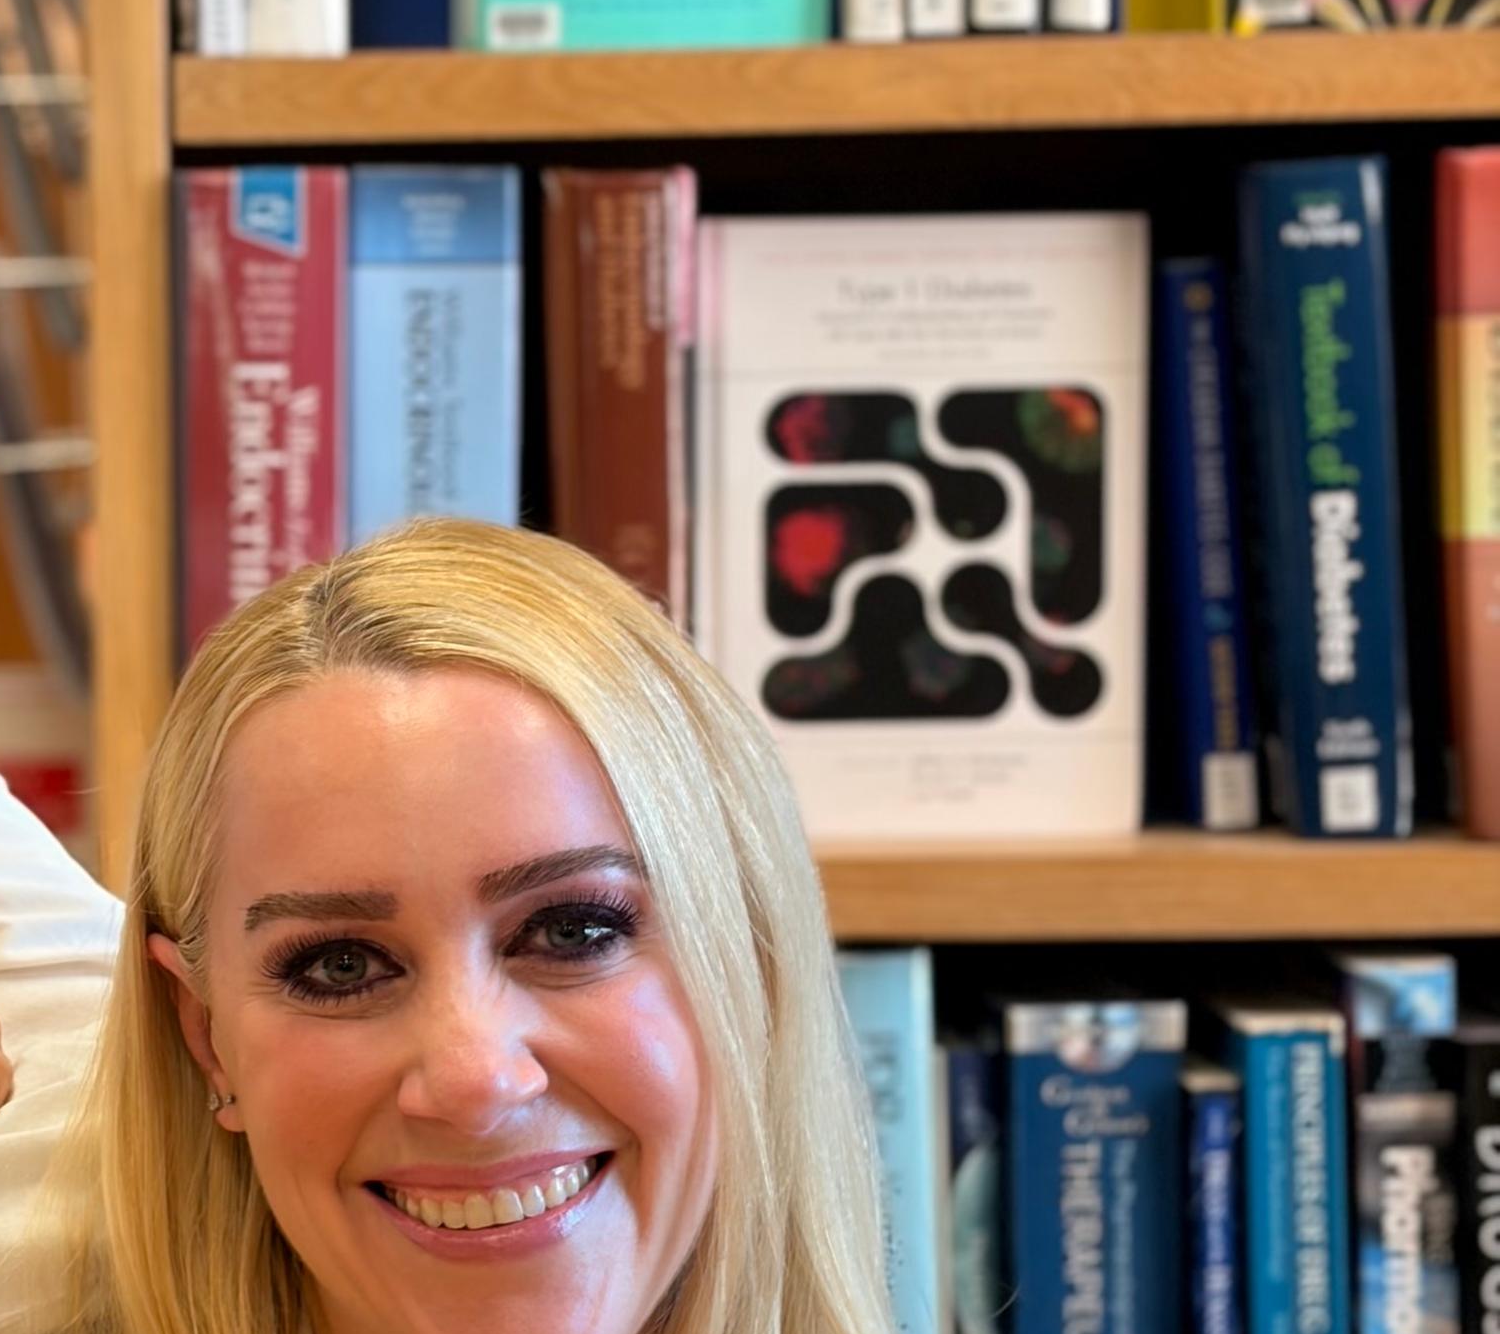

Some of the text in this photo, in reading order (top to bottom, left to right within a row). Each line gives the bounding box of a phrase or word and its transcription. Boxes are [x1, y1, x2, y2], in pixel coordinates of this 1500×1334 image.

[1300, 278, 1351, 436] Textbook
[1307, 440, 1361, 487] of
[1310, 488, 1364, 685] Diabetes
